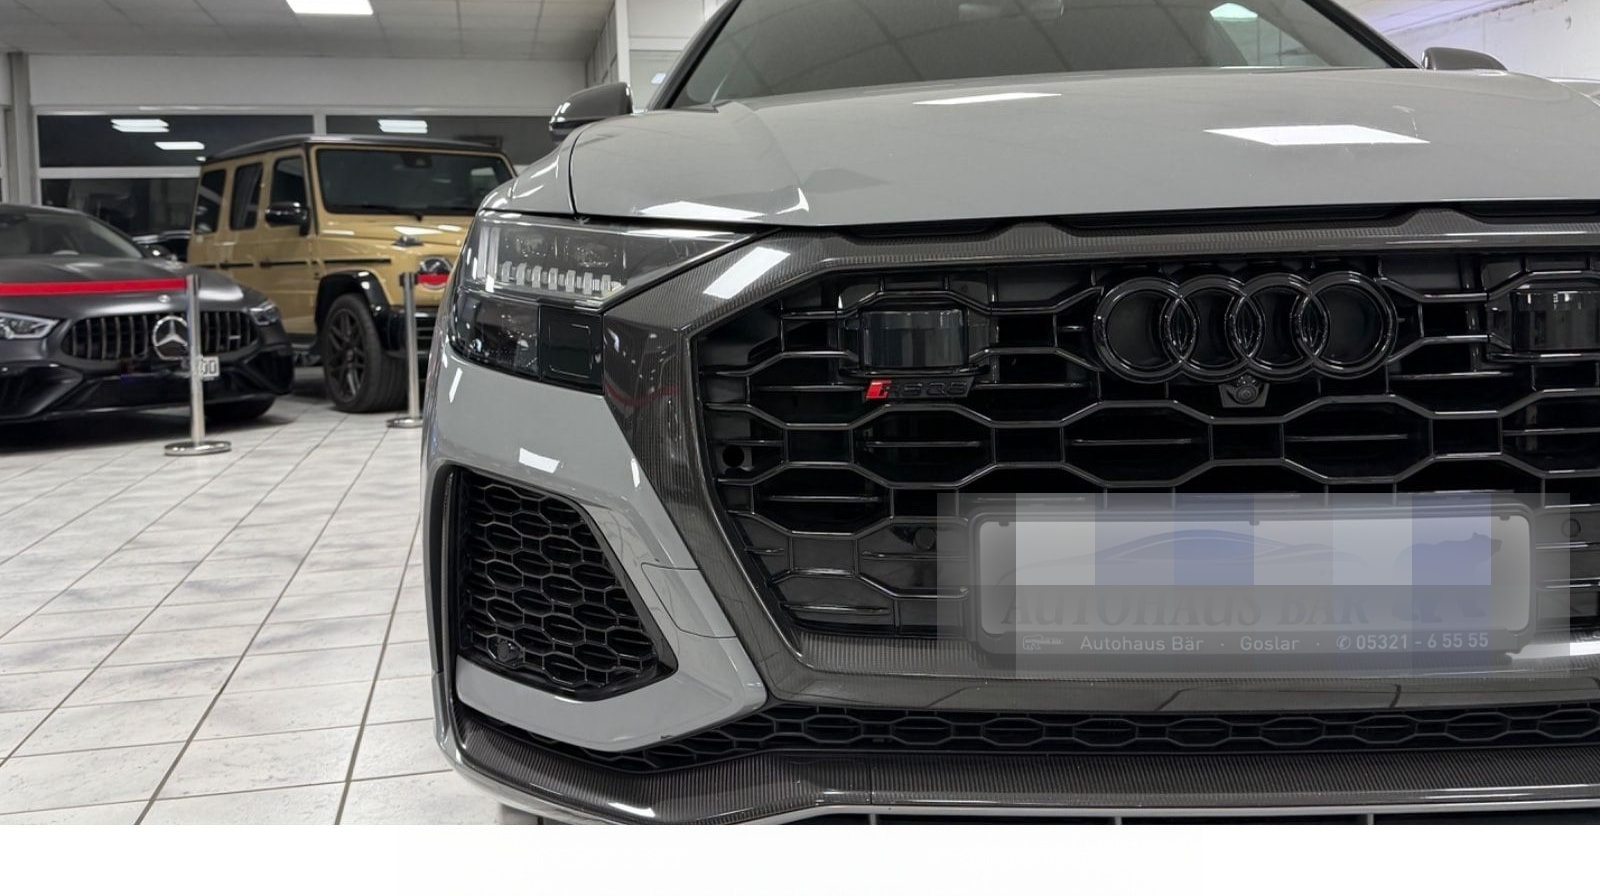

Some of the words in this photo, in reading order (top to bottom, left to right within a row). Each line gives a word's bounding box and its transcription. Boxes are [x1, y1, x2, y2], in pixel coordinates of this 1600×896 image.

[1080, 635, 1165, 652] Autohaus
[1171, 635, 1204, 652] Bär
[1240, 634, 1300, 652] Goslar
[1356, 634, 1409, 651] 05321
